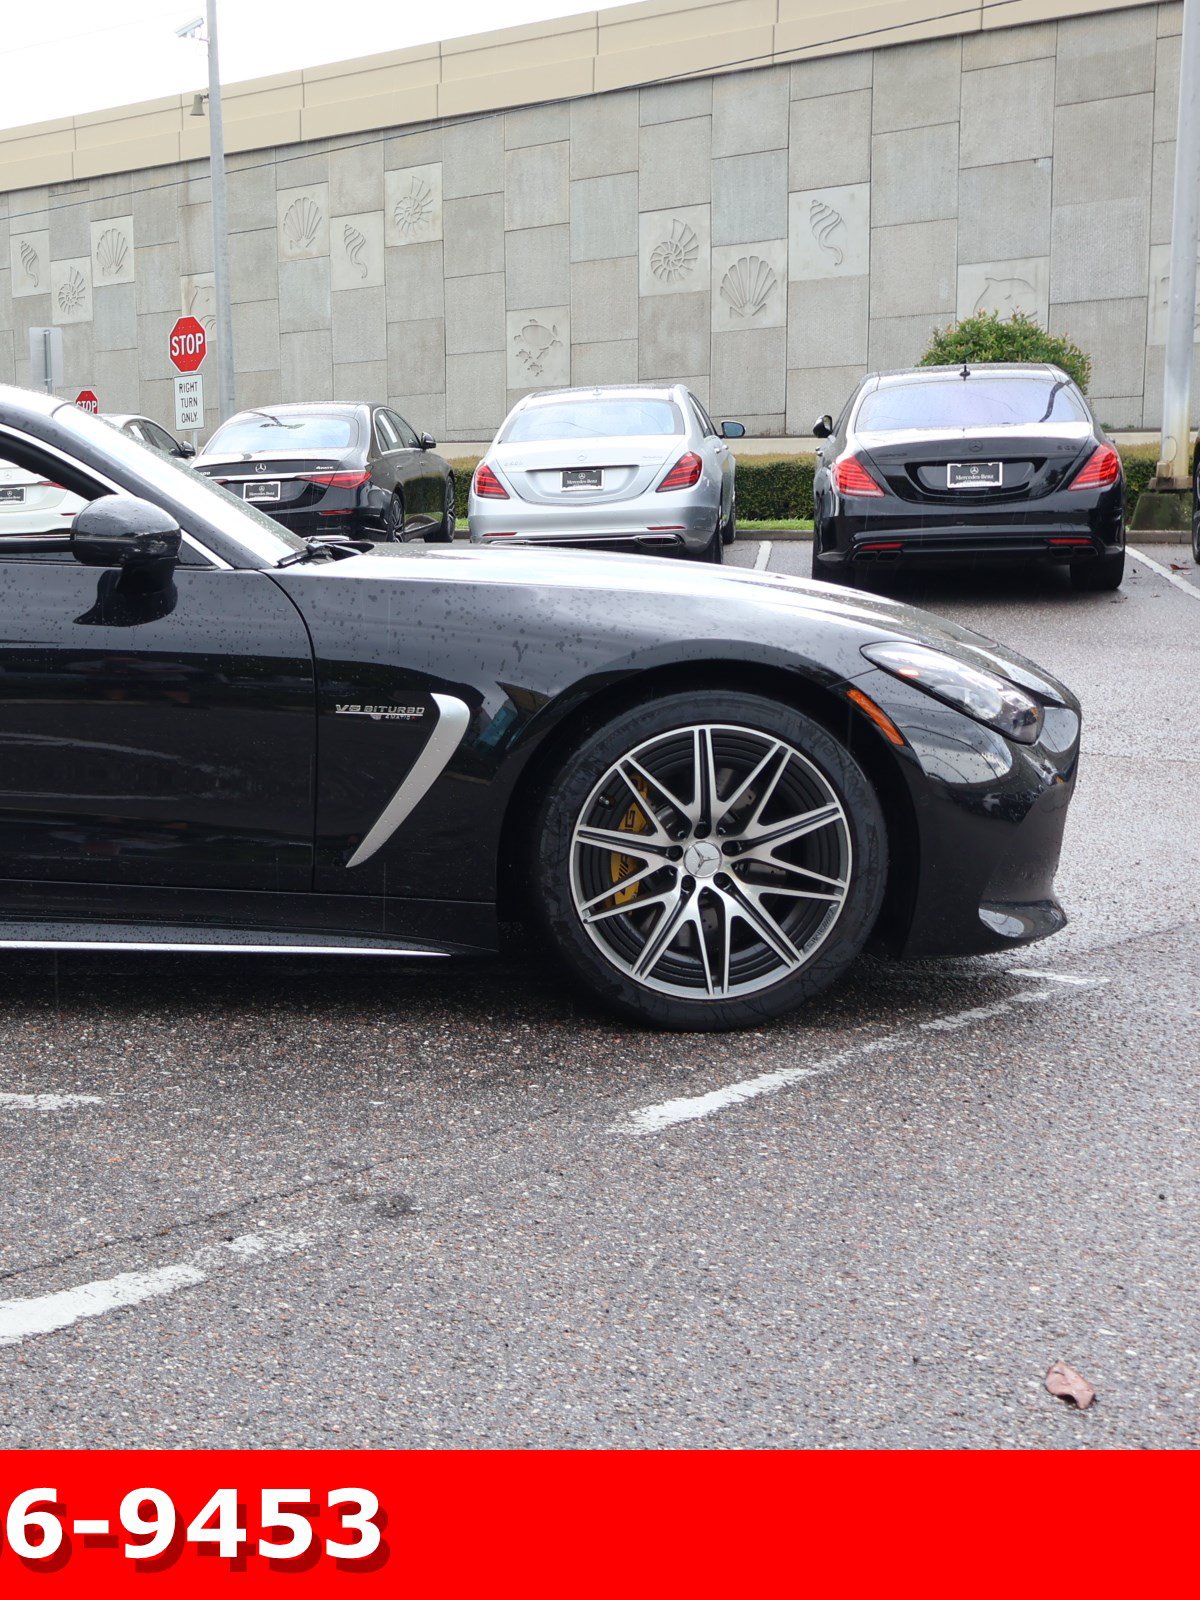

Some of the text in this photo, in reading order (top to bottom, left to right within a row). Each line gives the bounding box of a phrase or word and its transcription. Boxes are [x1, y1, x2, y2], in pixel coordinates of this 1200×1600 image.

[171, 333, 204, 356] STOP
[179, 381, 198, 393] RIGHT
[181, 397, 198, 408] TURN
[181, 412, 198, 423] ONLY
[335, 704, 425, 714] V8 BITURBO
